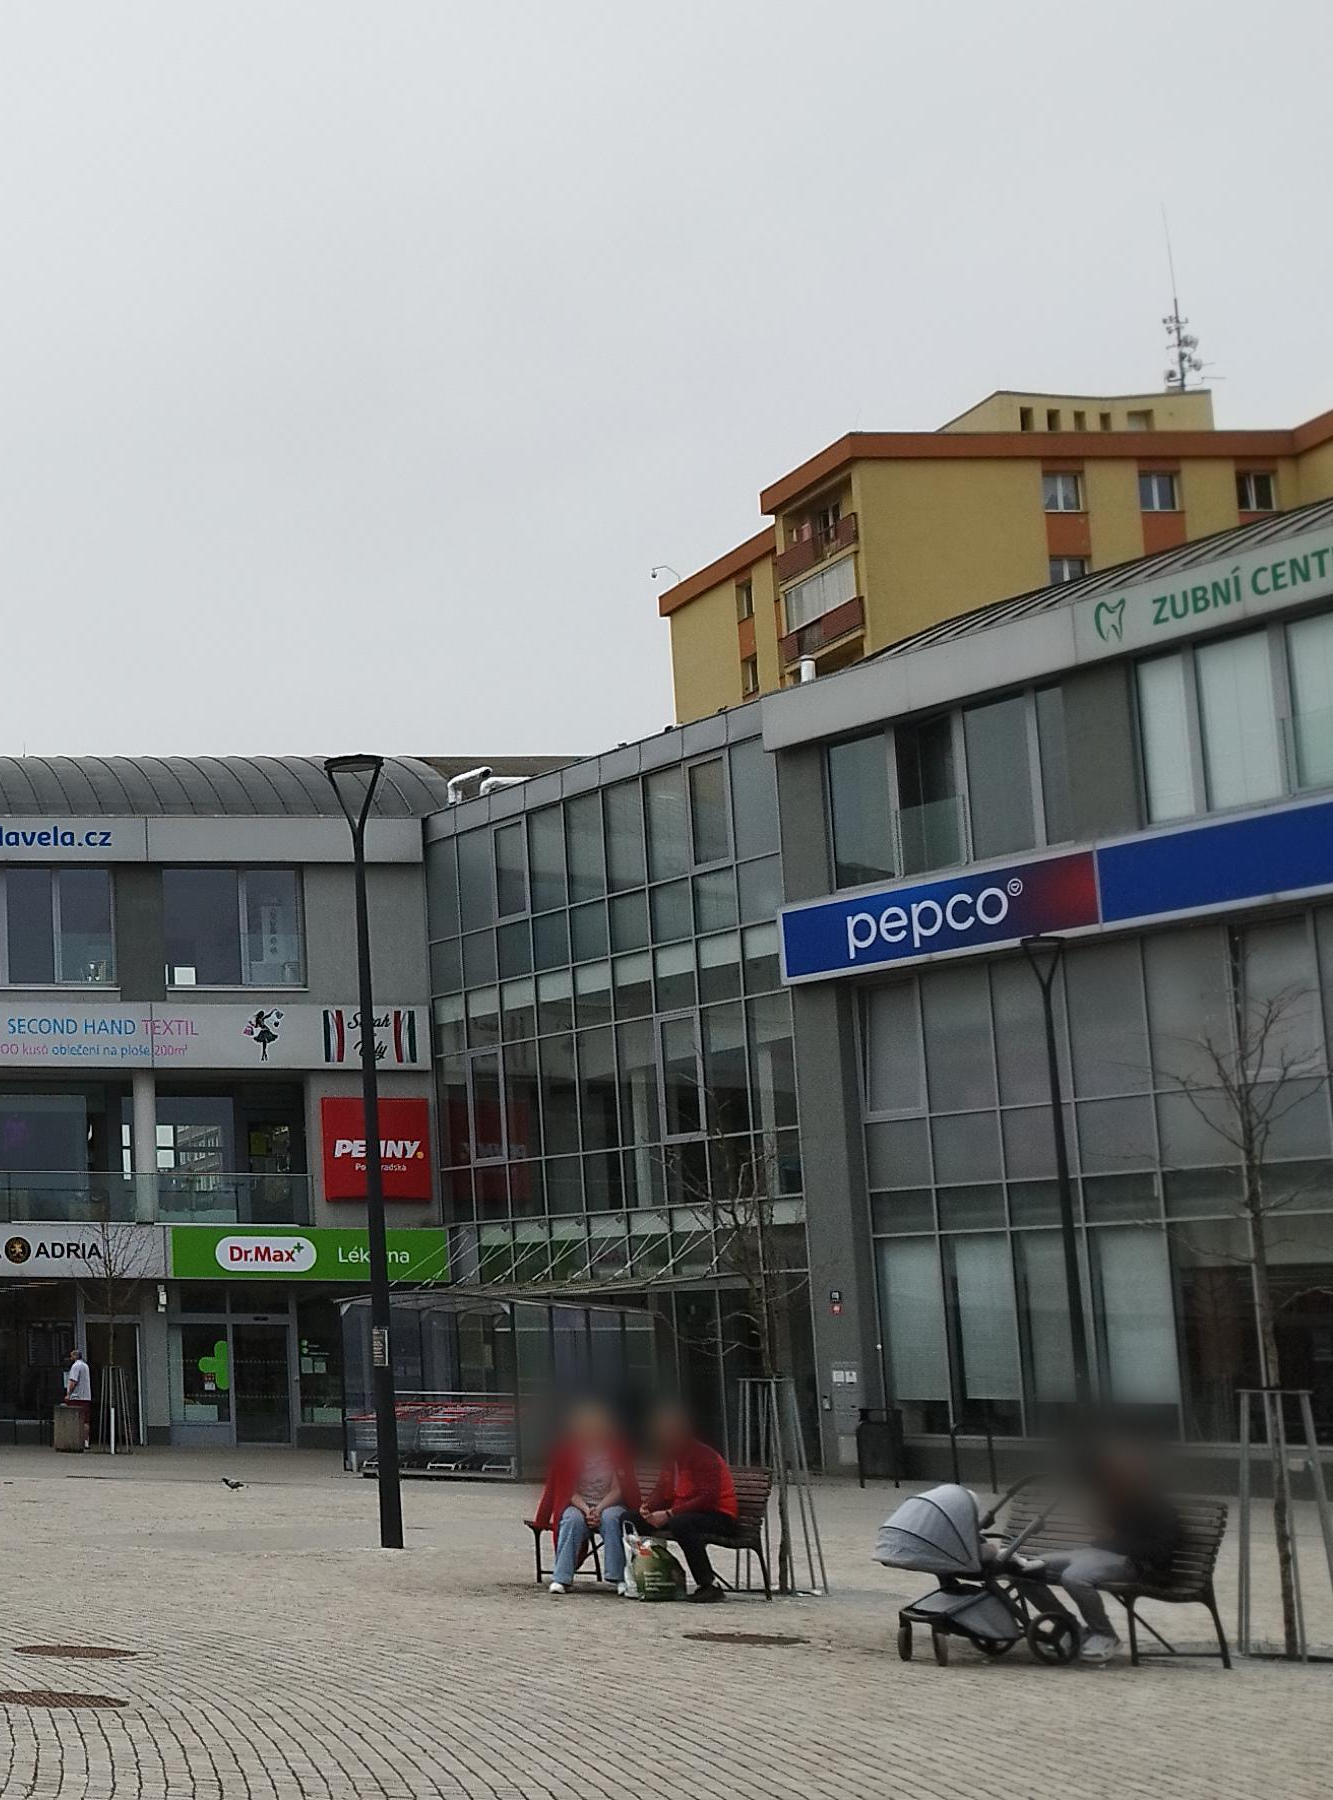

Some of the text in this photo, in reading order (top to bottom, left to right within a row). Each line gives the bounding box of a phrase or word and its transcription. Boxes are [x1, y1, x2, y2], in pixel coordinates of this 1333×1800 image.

[1152, 546, 1333, 626] ZUBNÍ CENT
[844, 886, 1010, 960] pepco
[7, 1018, 78, 1036] SECOND
[84, 1018, 136, 1036] HAND
[141, 1019, 199, 1036] TEXTIL
[52, 1043, 100, 1056] oblečení
[103, 1046, 118, 1056] na
[120, 1043, 151, 1058] ploše
[34, 1241, 102, 1262] ADRIA
[338, 1245, 410, 1264] Lékna
